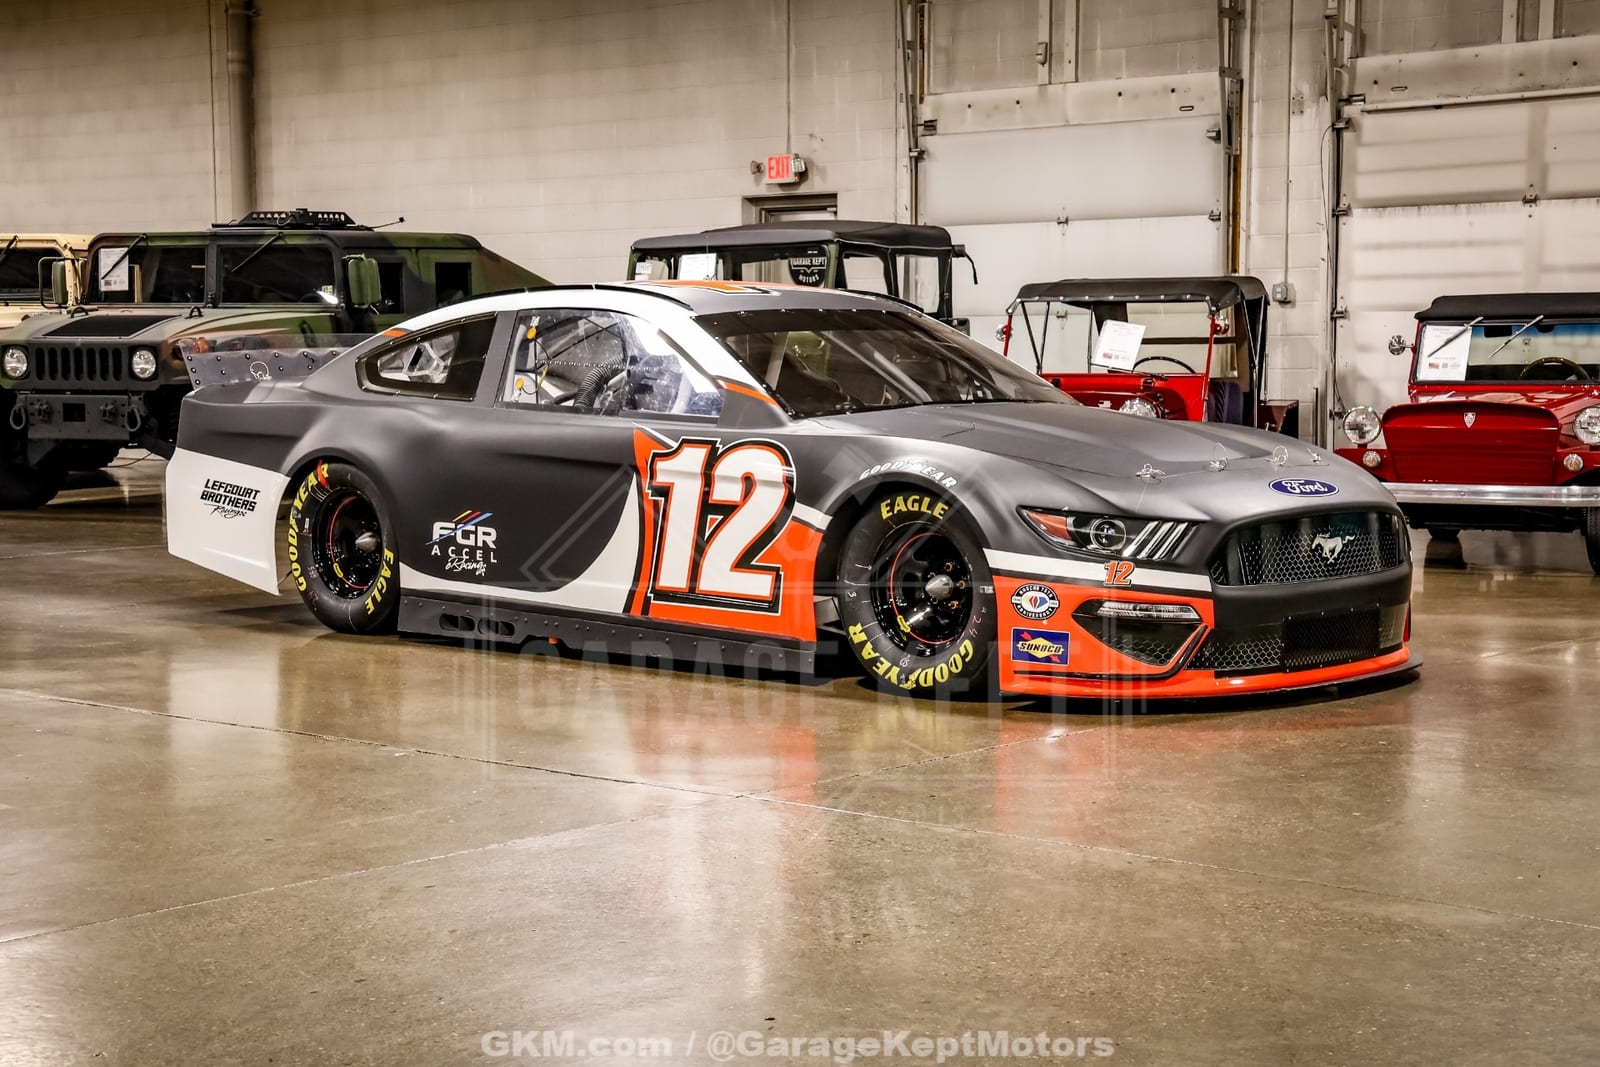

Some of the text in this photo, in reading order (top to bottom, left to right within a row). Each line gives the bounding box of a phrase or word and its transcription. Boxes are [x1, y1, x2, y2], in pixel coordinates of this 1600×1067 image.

[768, 155, 791, 179] EXIT
[799, 274, 820, 283] MOTORS
[204, 478, 261, 500] LEFCOURT
[1281, 480, 1328, 494] Ford
[200, 489, 257, 512] BROTHERS
[880, 495, 949, 520] EAGLE
[432, 521, 497, 549] FGR
[648, 439, 794, 610] 12
[431, 544, 498, 563] ACCEL
[364, 548, 394, 615] EAGLE
[1103, 560, 1135, 587] 12
[848, 622, 974, 690] GOODYEAR
[1019, 642, 1062, 655] SUNOCO
